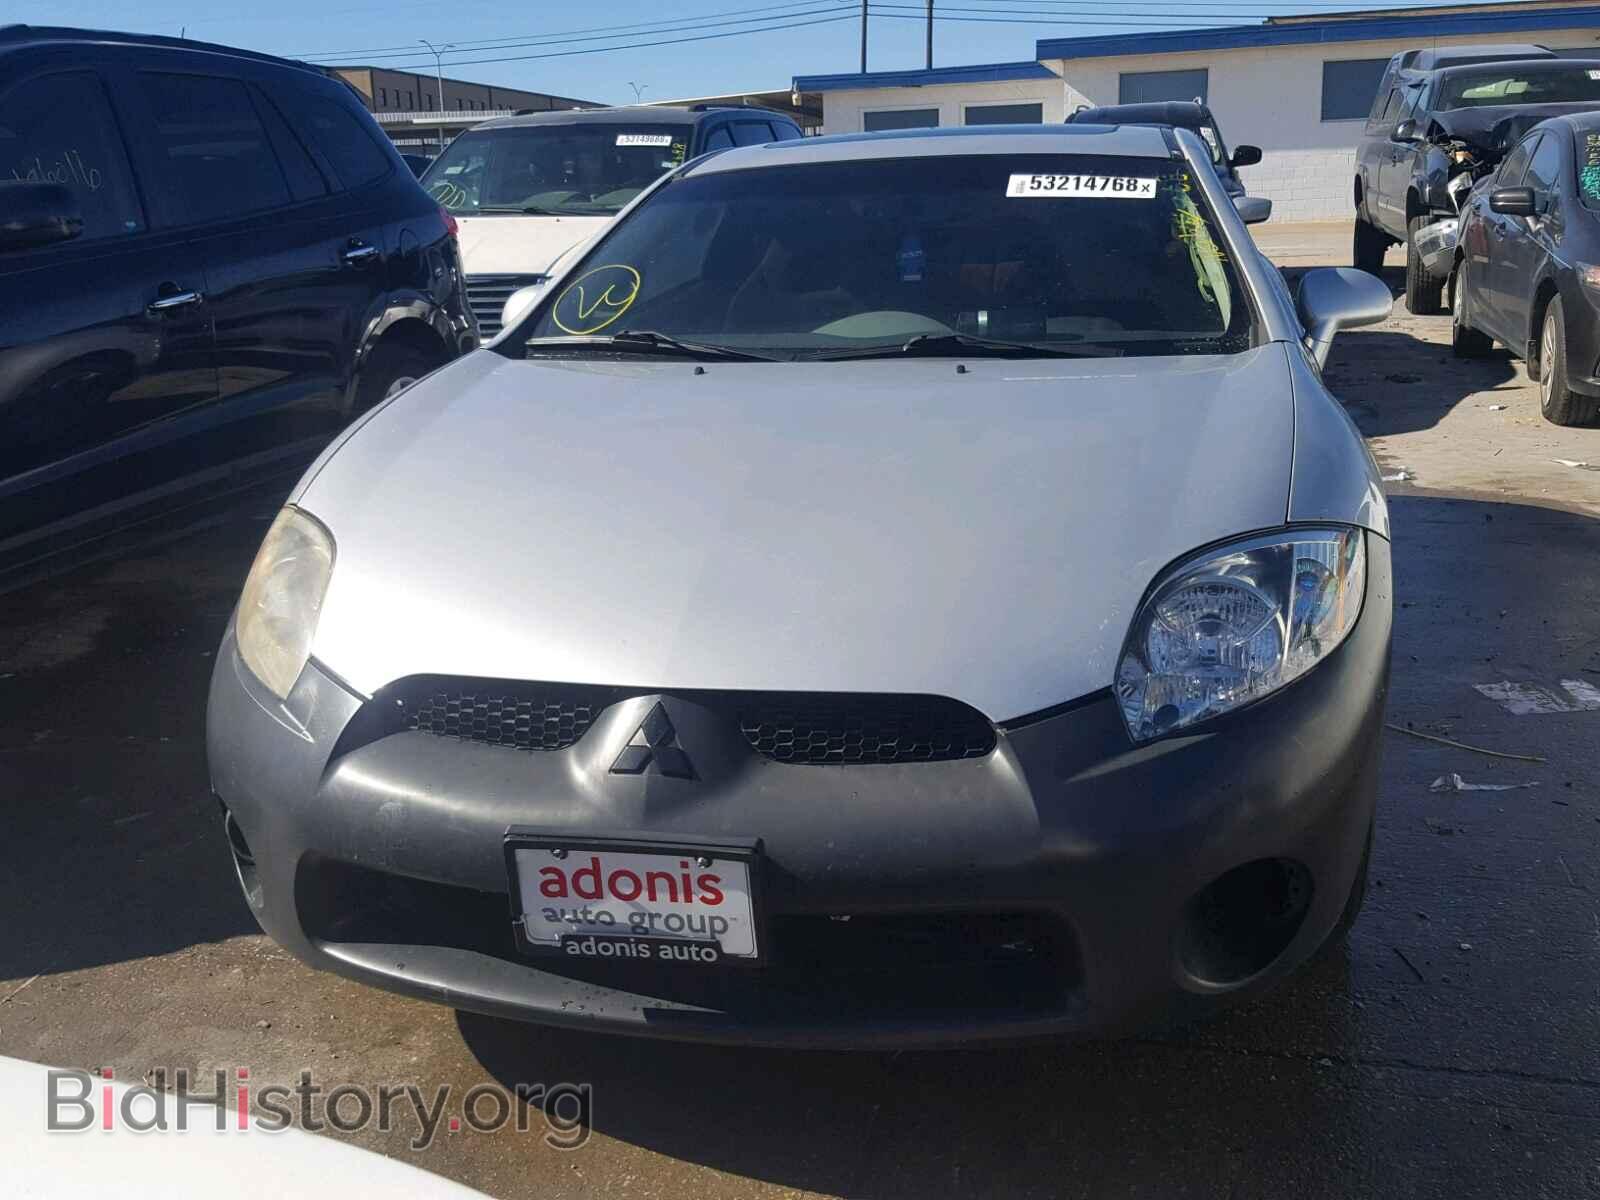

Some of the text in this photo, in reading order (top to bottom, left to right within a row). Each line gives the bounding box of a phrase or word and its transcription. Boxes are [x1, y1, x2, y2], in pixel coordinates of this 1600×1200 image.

[538, 856, 725, 906] adonis
[541, 904, 616, 926] auto
[565, 938, 719, 963] adonis auto
